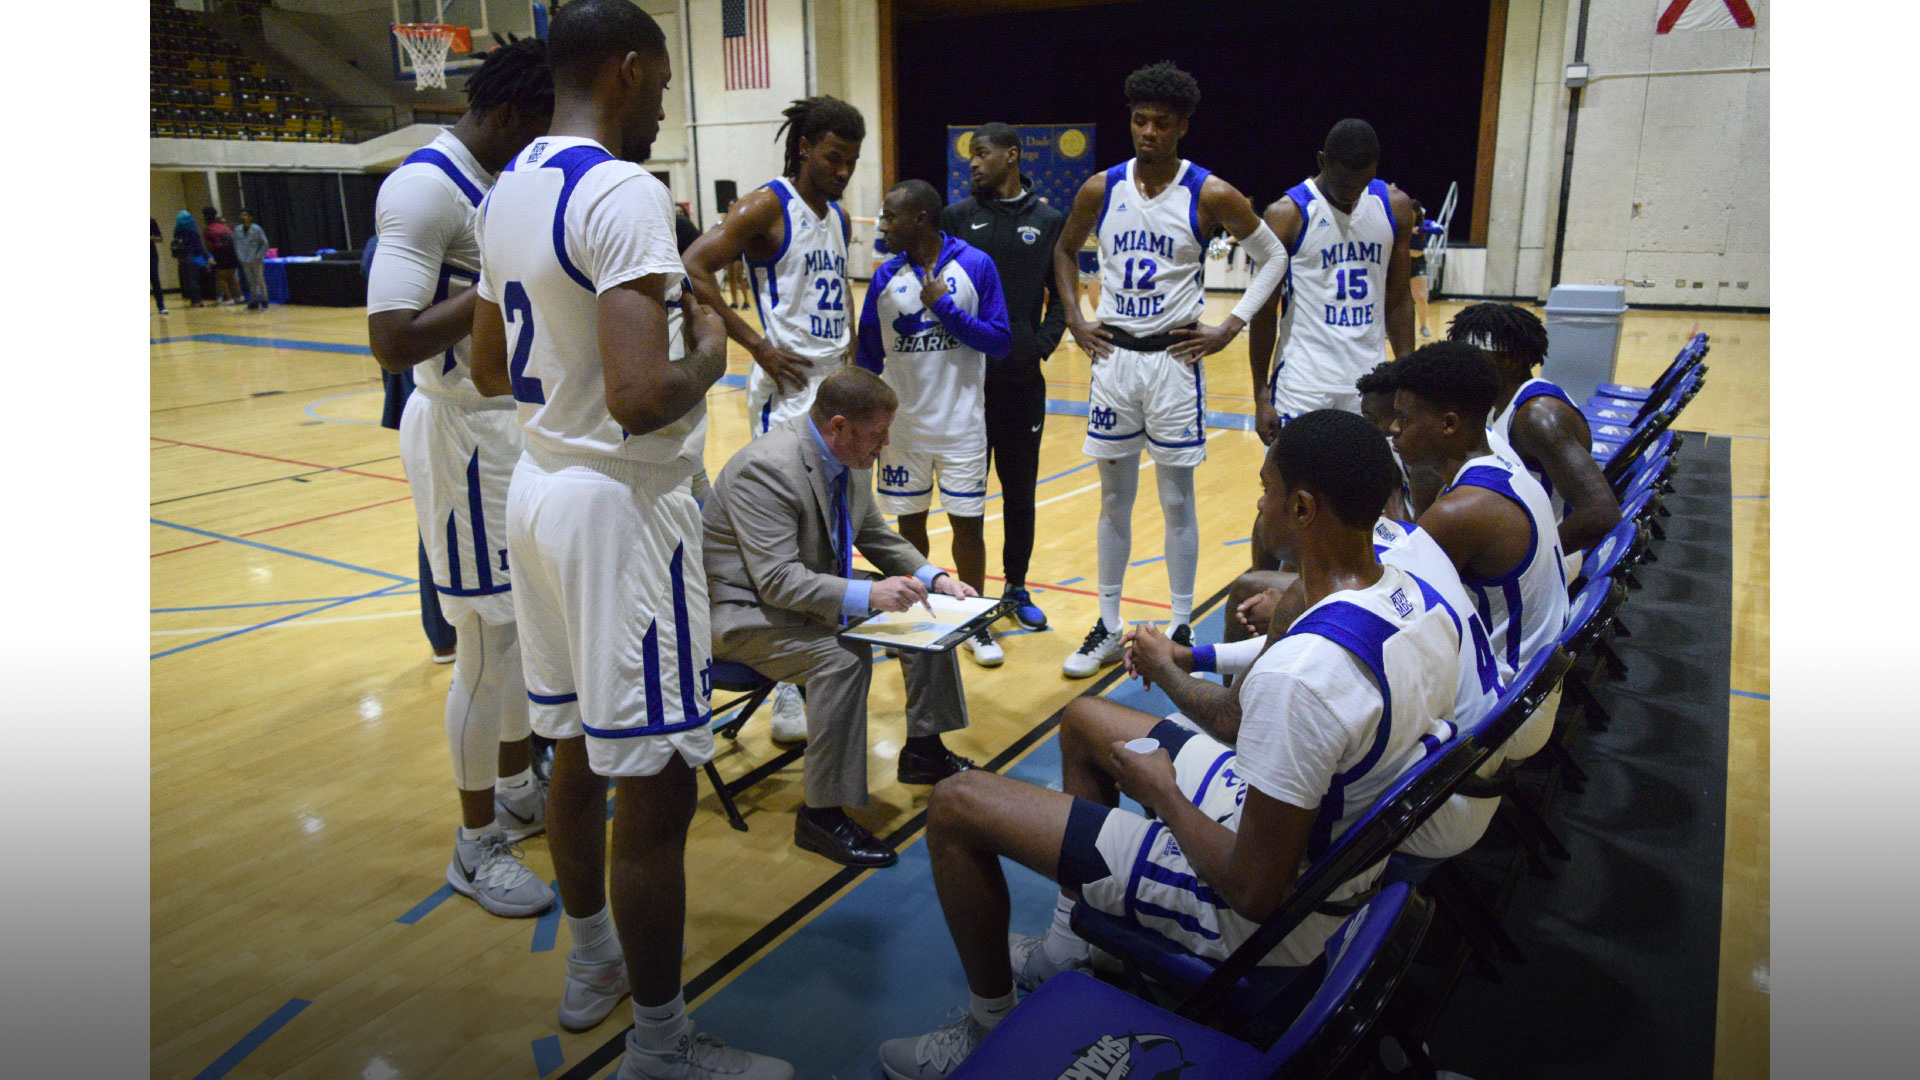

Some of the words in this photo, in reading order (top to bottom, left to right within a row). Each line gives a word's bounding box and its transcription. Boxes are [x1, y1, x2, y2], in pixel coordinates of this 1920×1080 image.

[1113, 230, 1175, 259] MIAMI
[1321, 241, 1382, 269] MIAMI
[1123, 257, 1157, 290] 12
[1336, 268, 1368, 300] 15
[815, 277, 844, 311] 22
[1115, 293, 1165, 318] DADE
[810, 314, 846, 339] DAD
[1324, 303, 1374, 327] DADE
[504, 281, 546, 406] 2
[893, 335, 962, 352] SHARKS
[1391, 590, 1407, 608] RUN
[1056, 1034, 1128, 1080] SHAR
